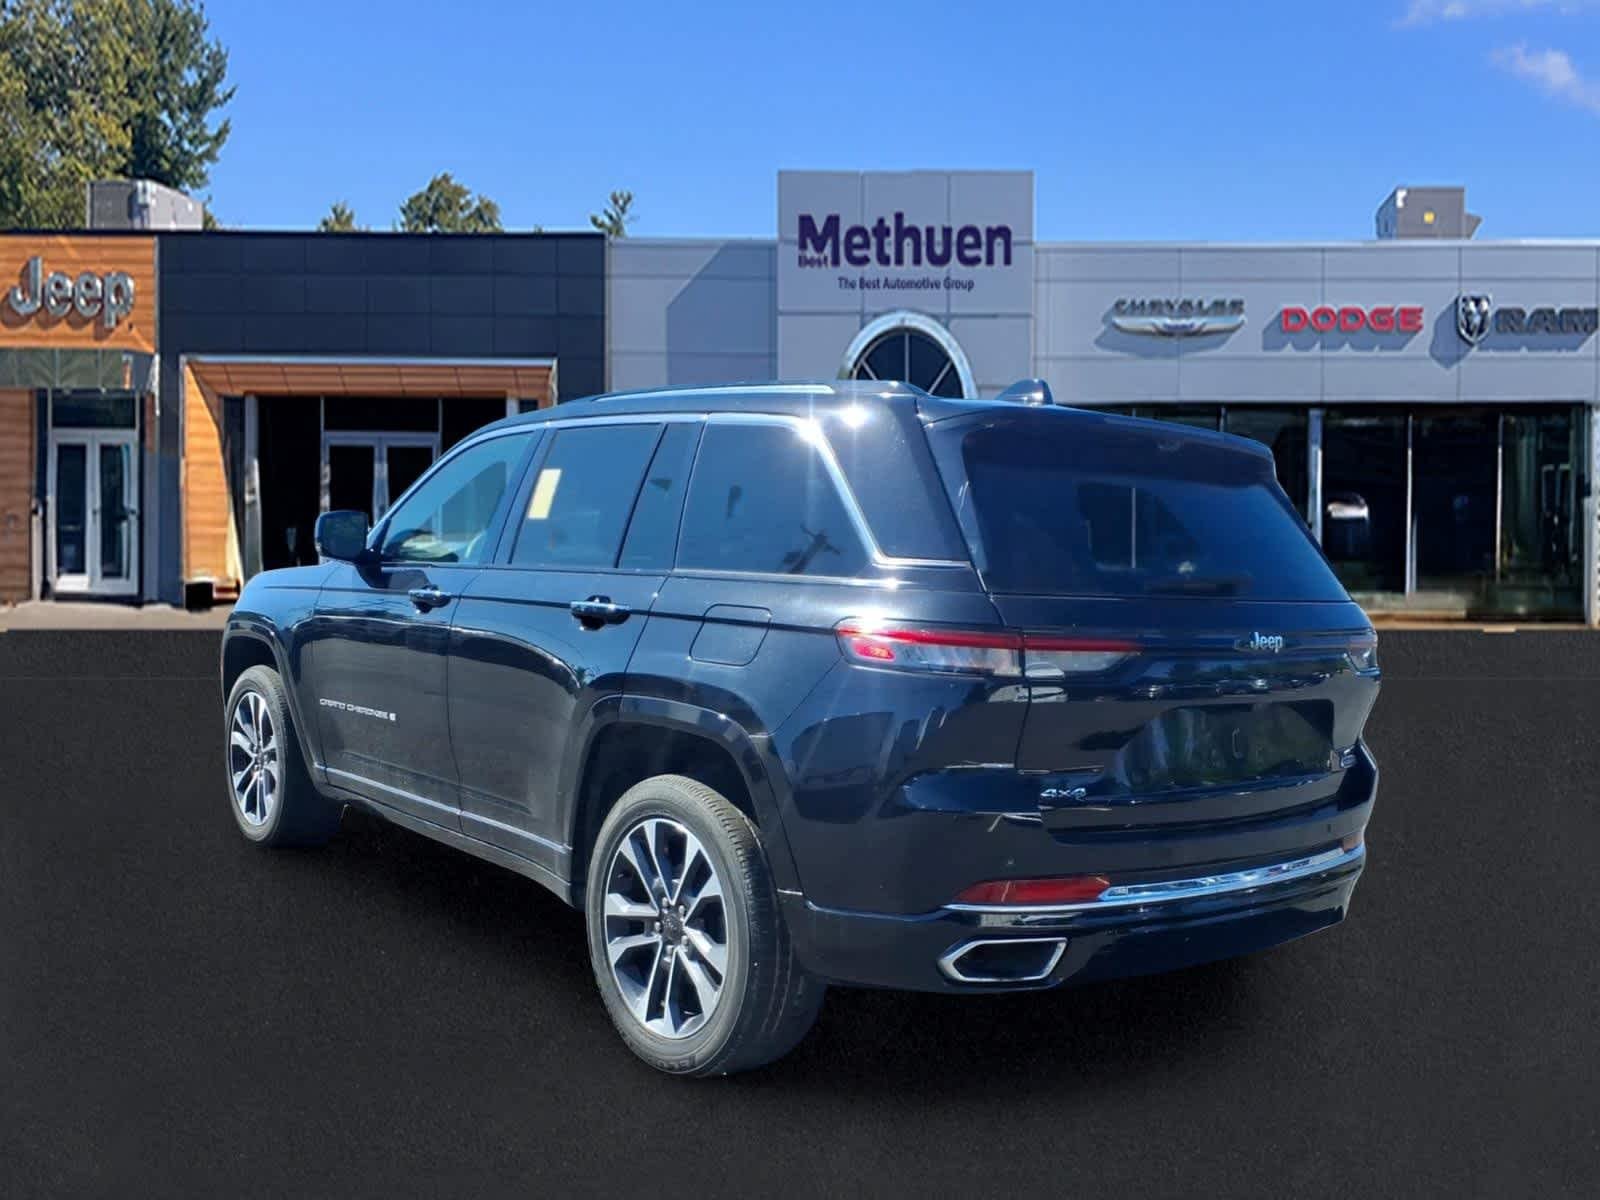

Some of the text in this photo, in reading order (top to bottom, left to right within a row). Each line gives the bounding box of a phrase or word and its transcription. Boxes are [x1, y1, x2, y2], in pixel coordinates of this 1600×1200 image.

[798, 212, 1012, 267] Methuen
[798, 254, 828, 268] Best
[9, 256, 135, 329] Jeep
[838, 276, 974, 292] The Best Automotive Group
[1281, 306, 1423, 332] DODGE
[1495, 307, 1598, 333] RAM
[1250, 631, 1283, 653] Jeep
